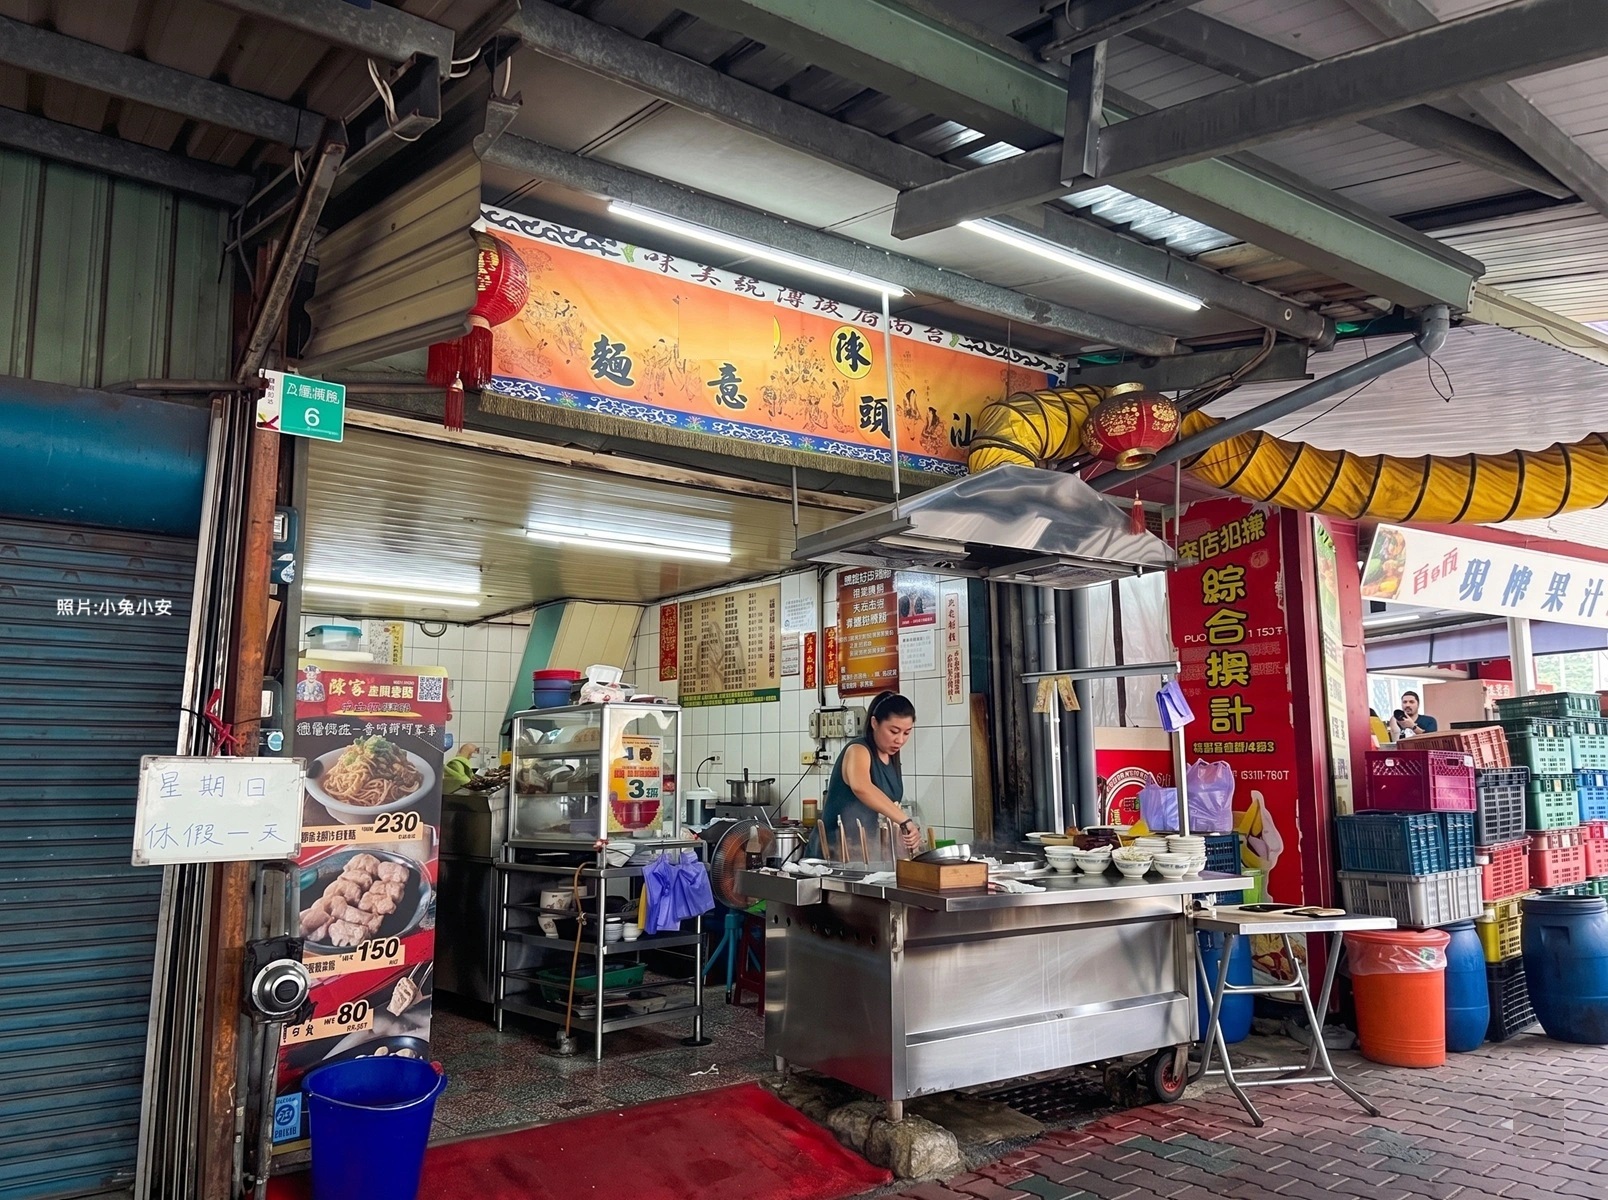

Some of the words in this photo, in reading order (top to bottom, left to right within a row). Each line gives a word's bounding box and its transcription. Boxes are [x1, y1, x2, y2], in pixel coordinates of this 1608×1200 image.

[304, 407, 320, 427] 6
[160, 771, 266, 799] 星期日
[628, 779, 645, 799] 3
[375, 813, 418, 834] 230
[145, 822, 287, 850] 休假一天
[358, 938, 399, 962] 150
[337, 1001, 368, 1025] 80
